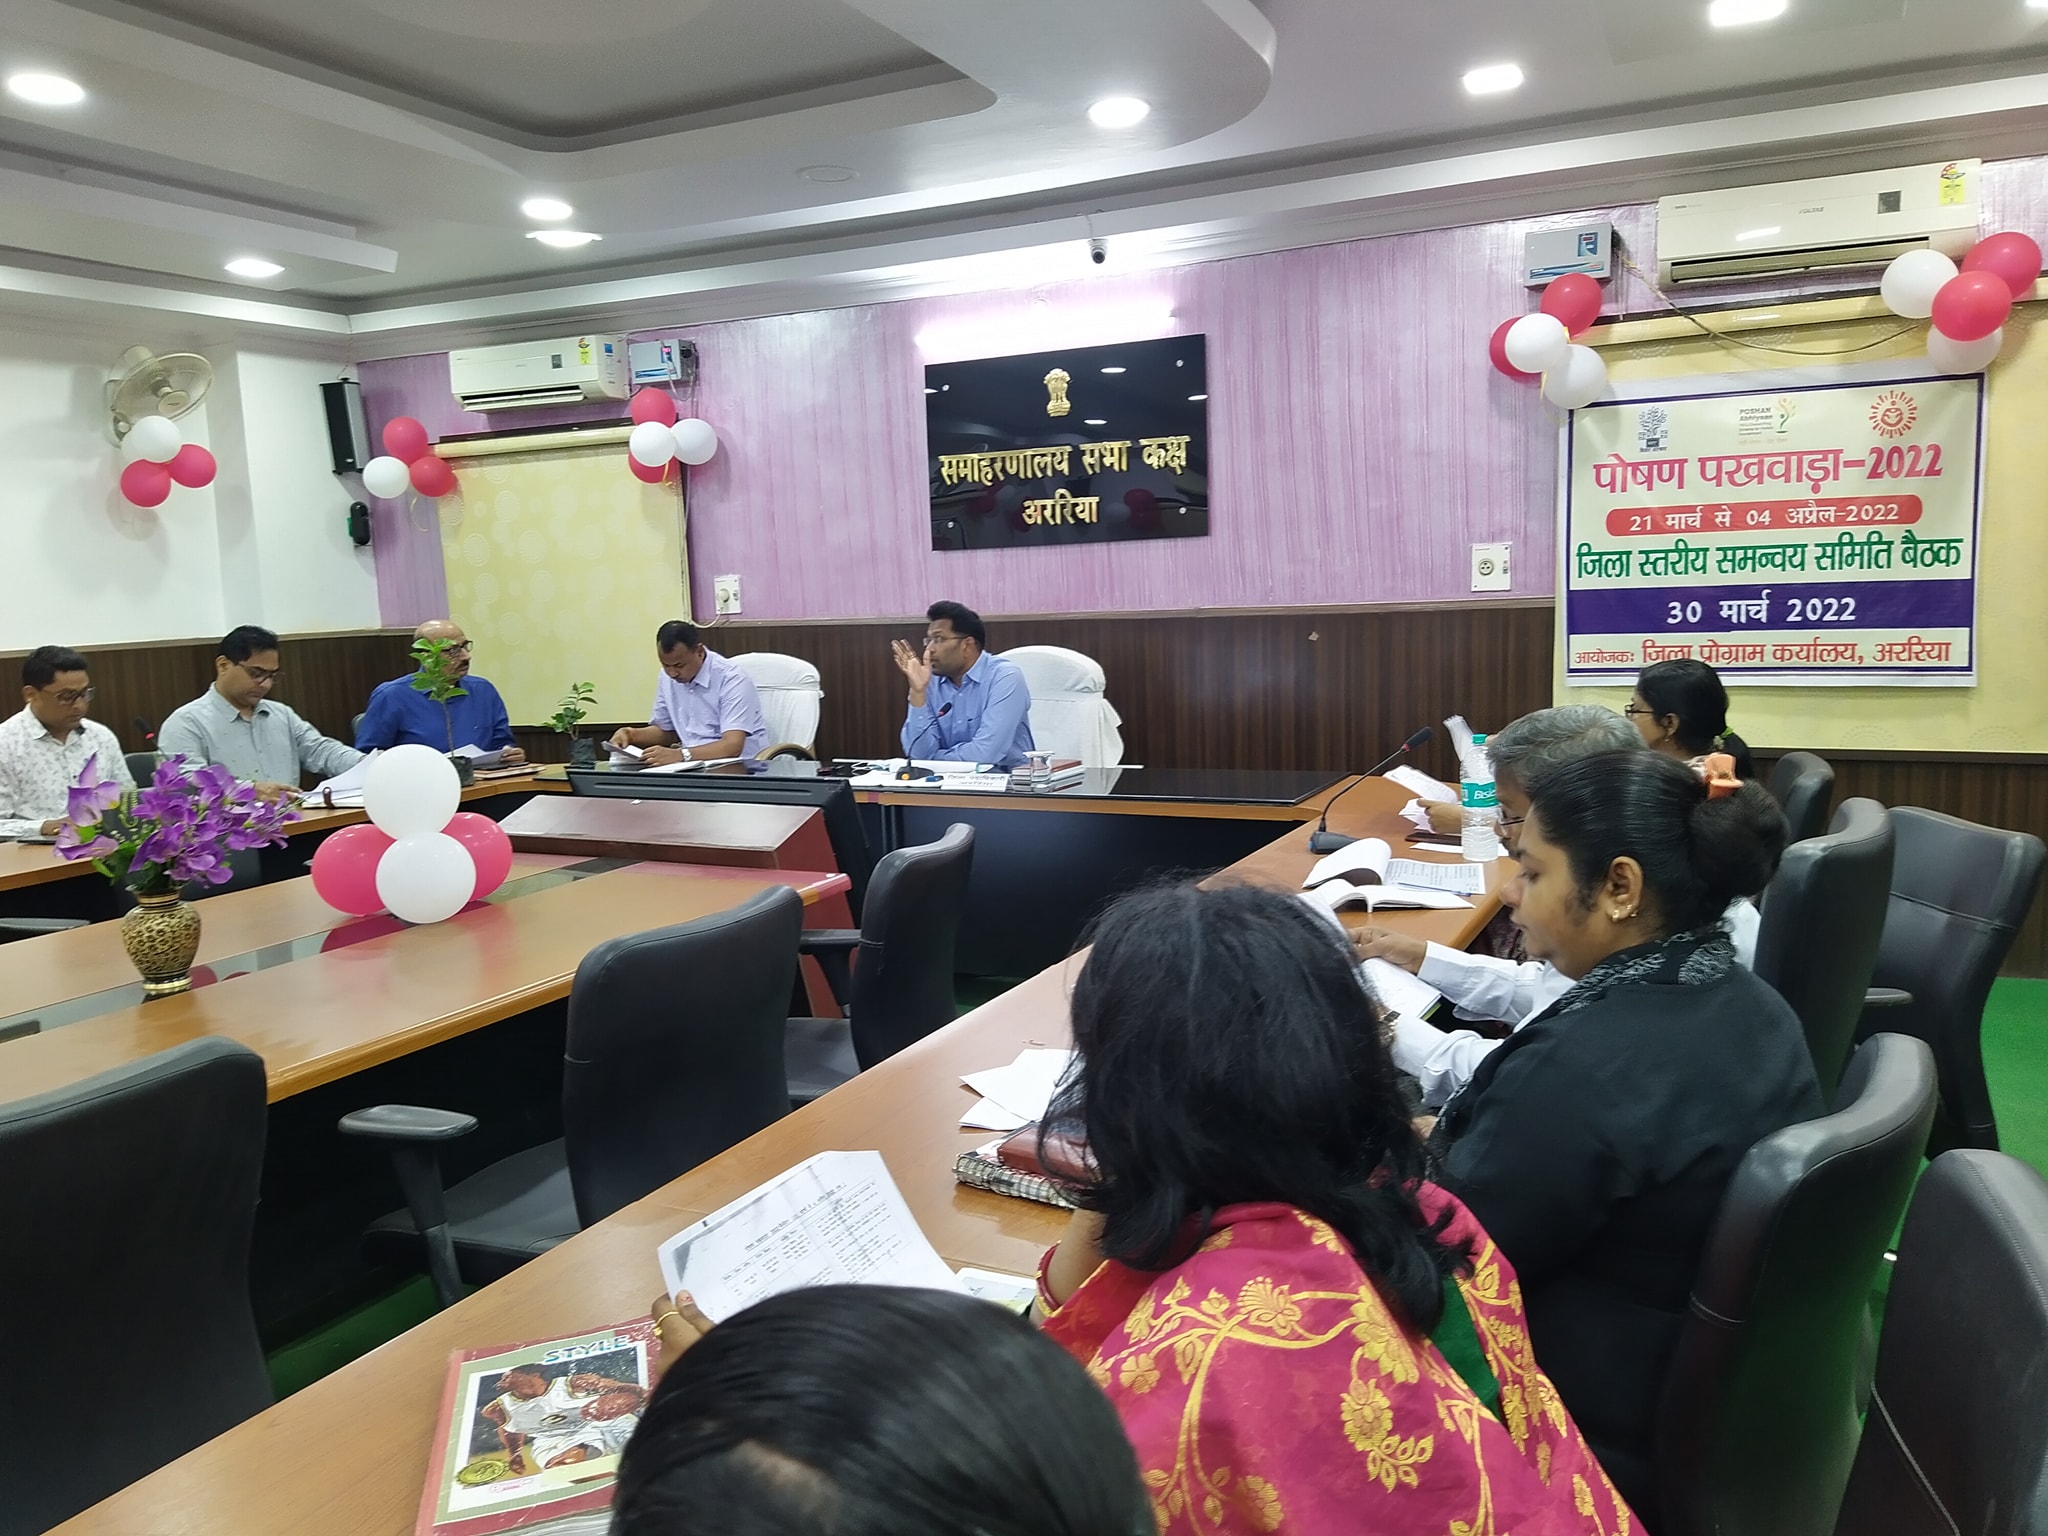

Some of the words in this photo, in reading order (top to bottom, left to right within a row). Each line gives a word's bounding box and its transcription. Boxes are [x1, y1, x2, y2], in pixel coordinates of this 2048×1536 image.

[938, 445, 1073, 486] समाहरणालय
[1079, 440, 1131, 475] सभा
[1139, 435, 1191, 475] कक्ष
[1592, 453, 1688, 493] पोषण
[1022, 488, 1100, 526] अररिया
[1630, 516, 1652, 532] 21
[1665, 506, 1703, 530] मार्च
[1714, 505, 1732, 528] से
[1746, 510, 1771, 526] 04
[1785, 500, 1899, 525] अप्रैल-2022
[1576, 542, 1632, 578] जिला
[1638, 538, 1710, 577] स्तरीय
[1716, 543, 1808, 574] समन्वय
[1814, 531, 1894, 571] समिति
[1900, 529, 1964, 568] बैठक
[1666, 601, 1702, 624] 30
[1718, 589, 1772, 623] मार्च
[1786, 597, 1856, 622] 2022
[1641, 639, 1694, 663] जिला
[1699, 639, 1766, 665] प्रोग्राम
[1872, 635, 1952, 662] अररिया
[544, 1335, 630, 1363] STYLE
